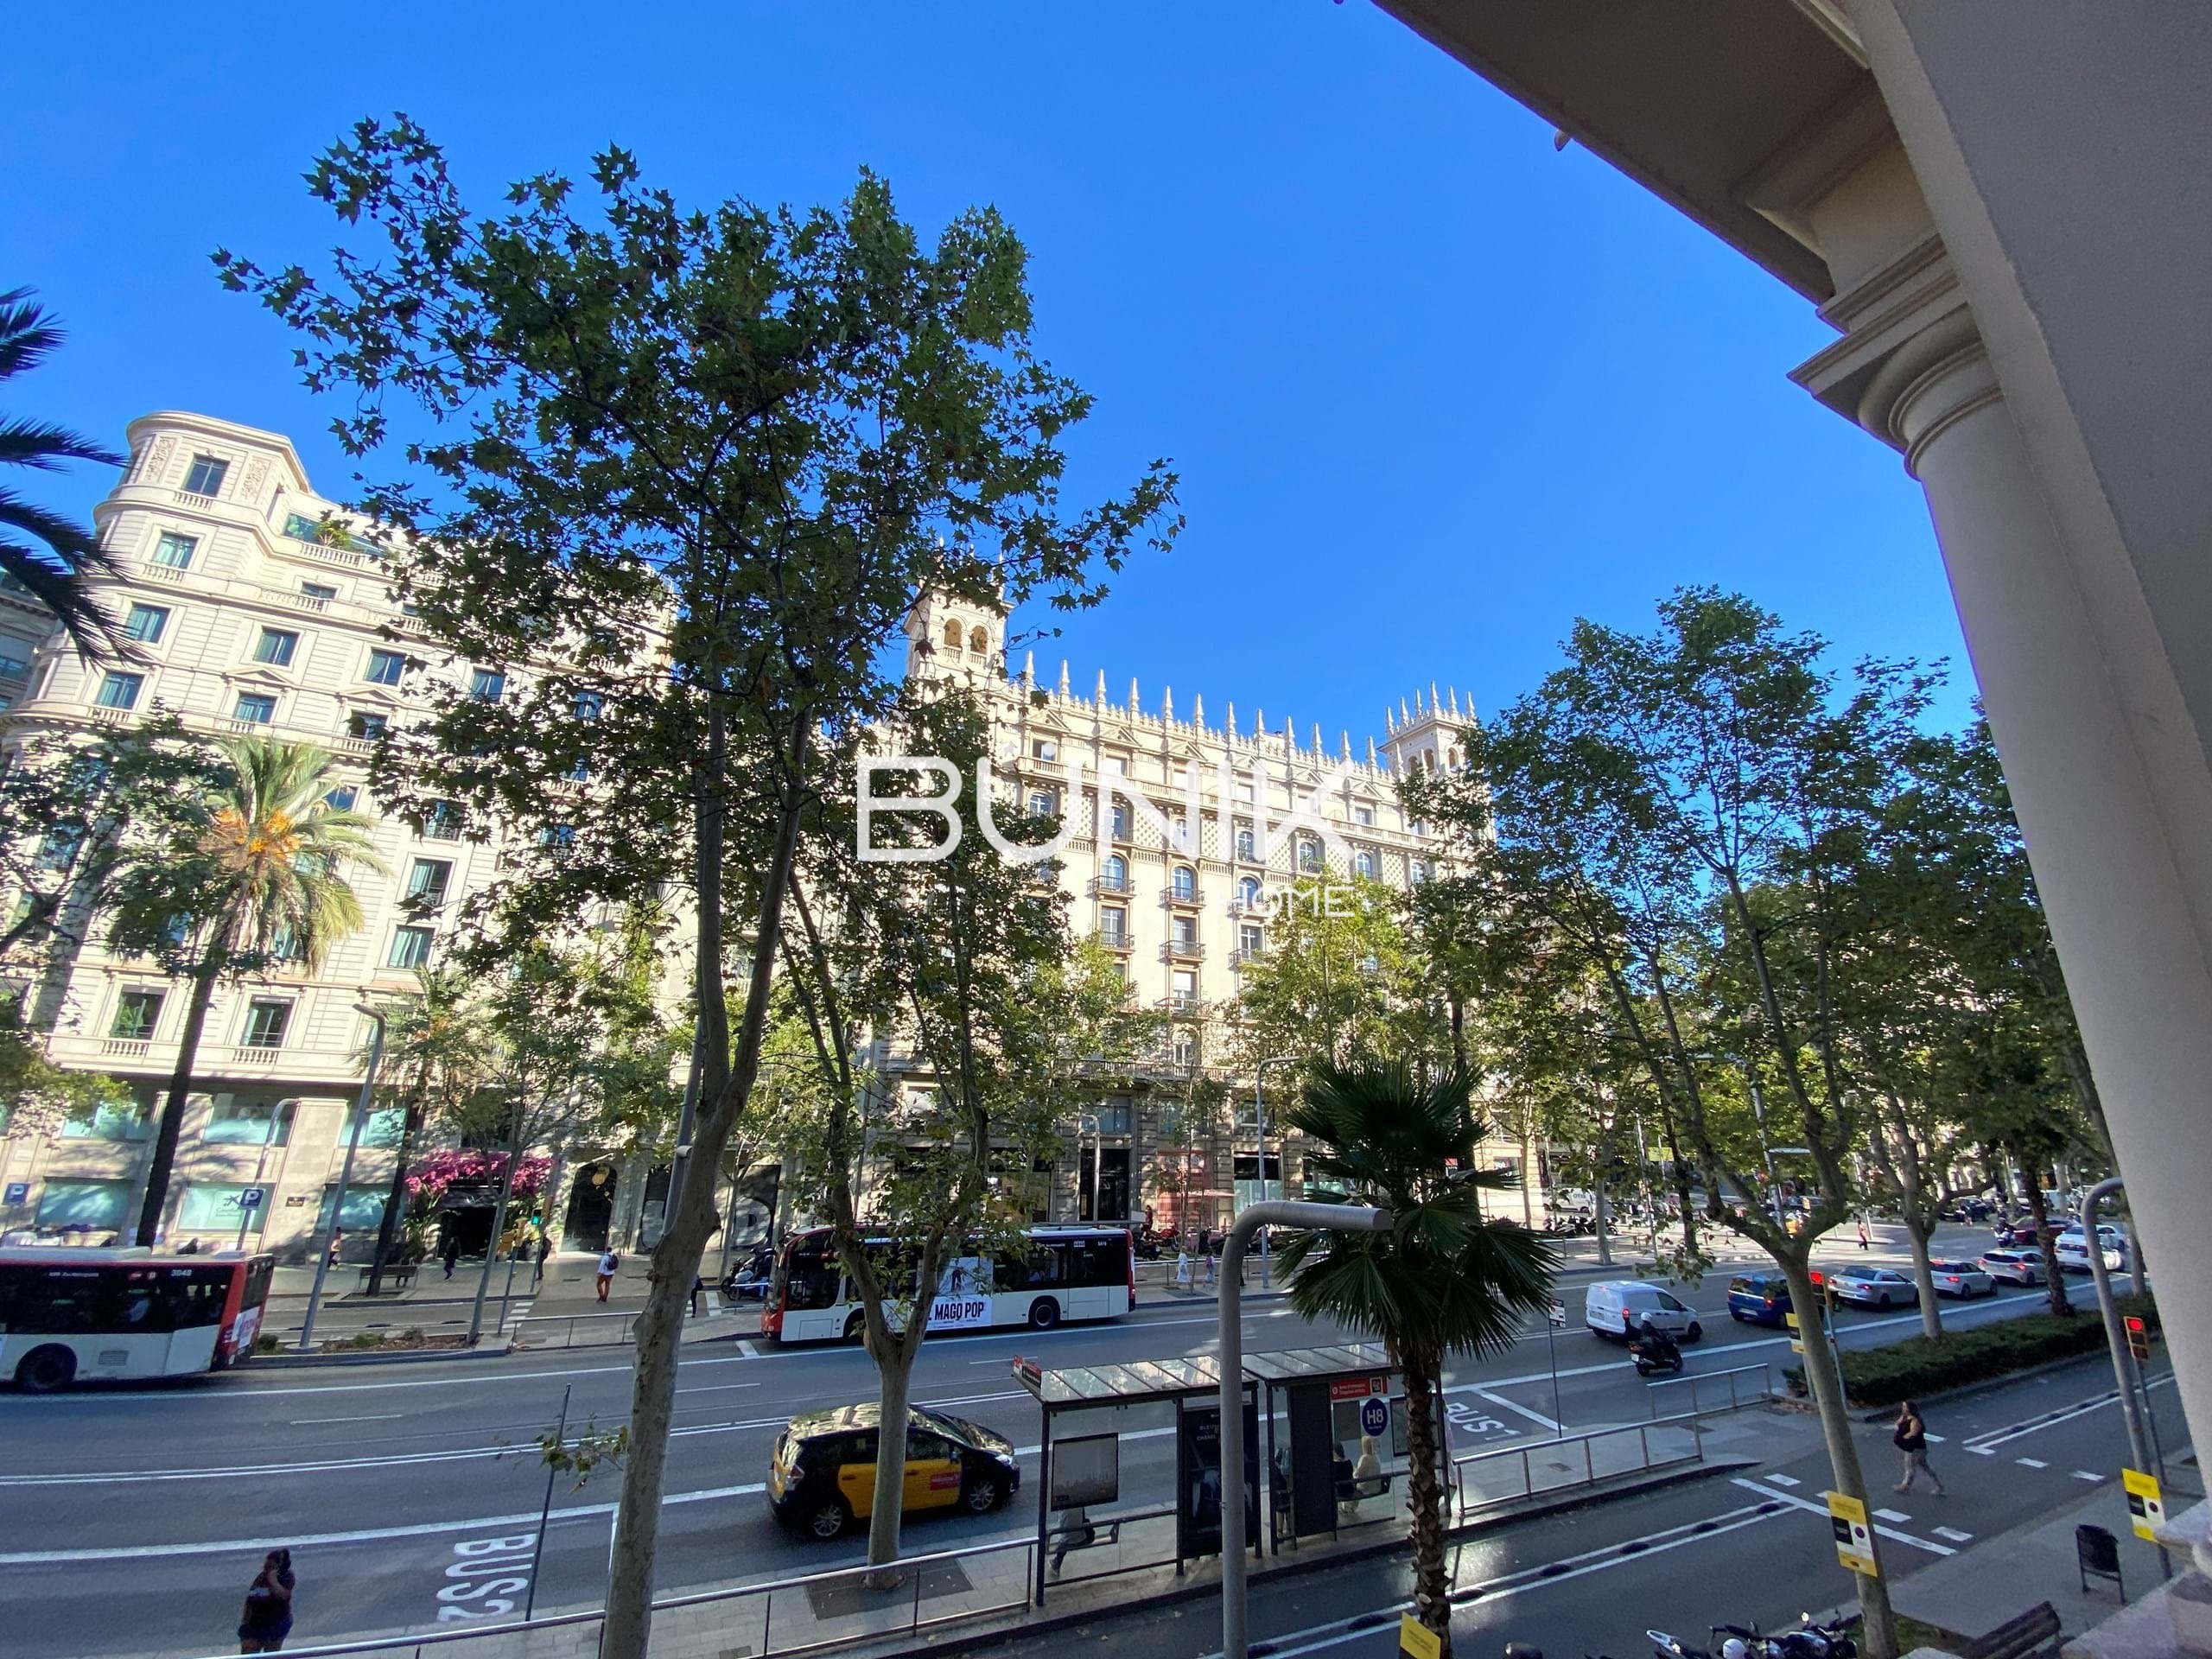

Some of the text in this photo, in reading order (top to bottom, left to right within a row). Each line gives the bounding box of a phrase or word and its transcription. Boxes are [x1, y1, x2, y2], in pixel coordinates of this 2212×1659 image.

[10, 1184, 25, 1200] P
[244, 1189, 259, 1205] P
[934, 1301, 984, 1321] MAGO POP
[1366, 1408, 1384, 1425] H8
[435, 1533, 538, 1622] BUS2
